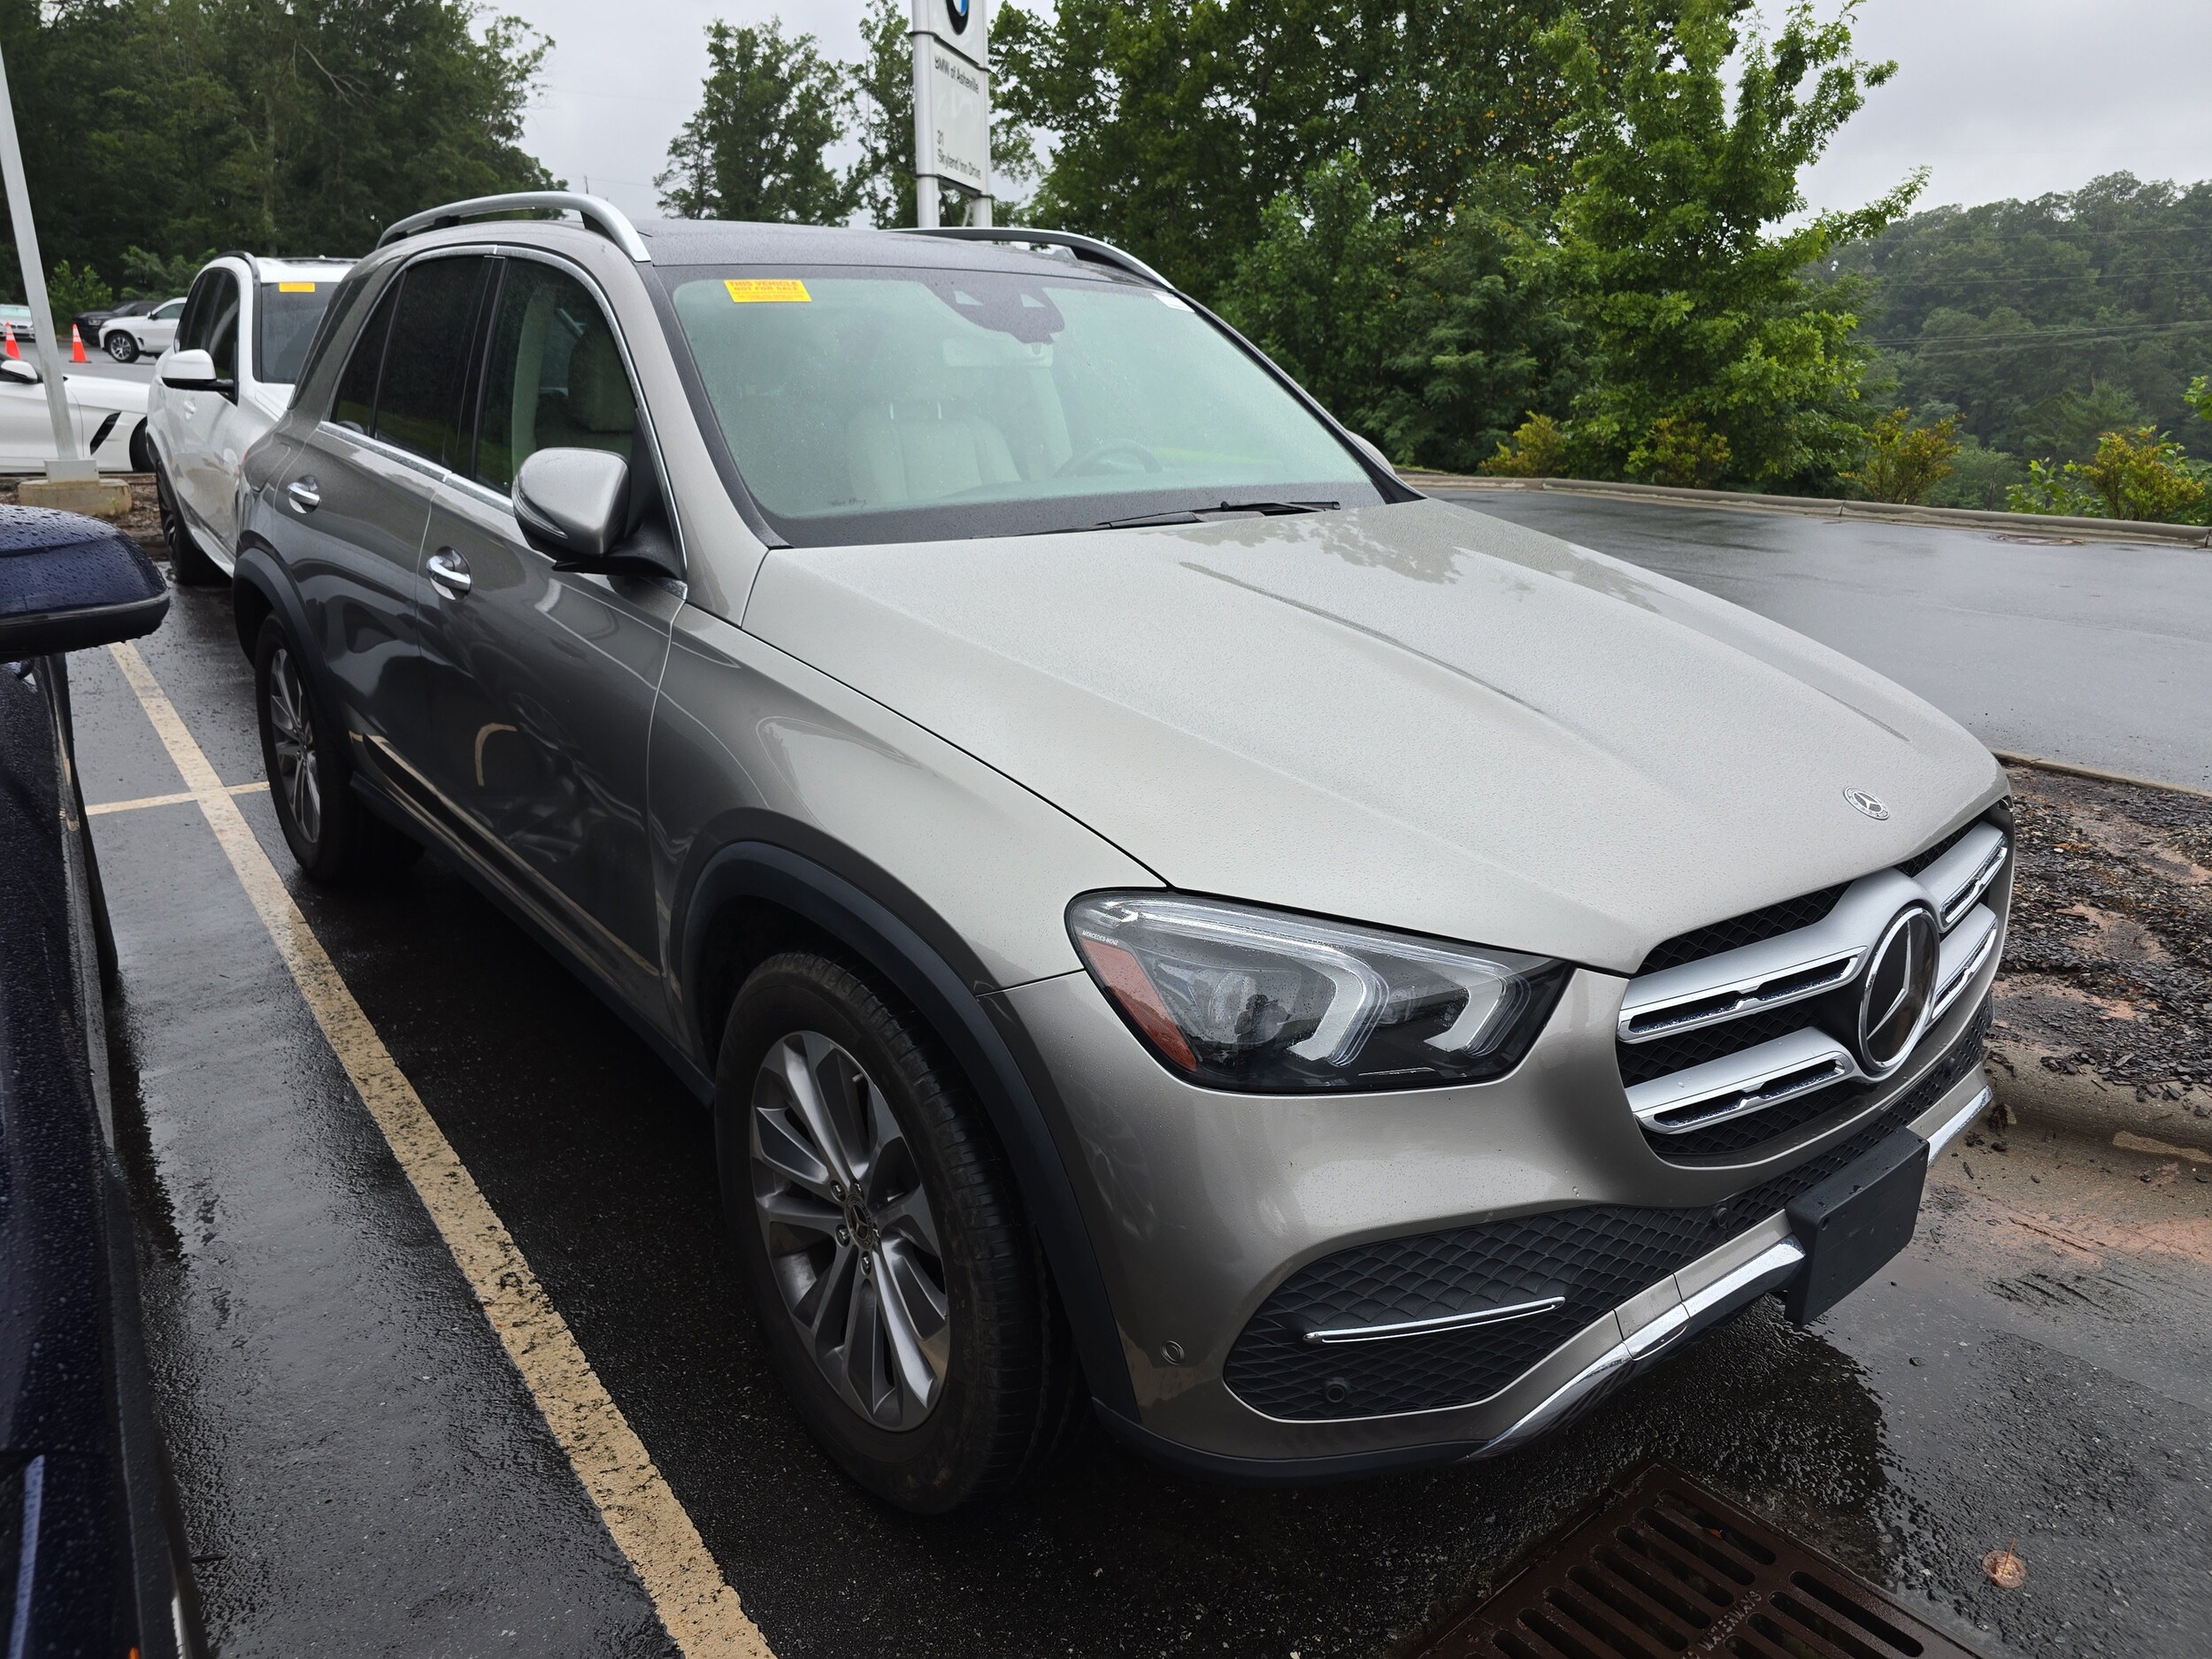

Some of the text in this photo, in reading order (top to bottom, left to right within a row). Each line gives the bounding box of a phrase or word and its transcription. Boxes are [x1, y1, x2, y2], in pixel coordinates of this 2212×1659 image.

[934, 56, 979, 94] BMW of Asheville
[1082, 930, 1118, 946] MERCEDES-BENZ
[1697, 1590, 1762, 1651] WATERWAYS
